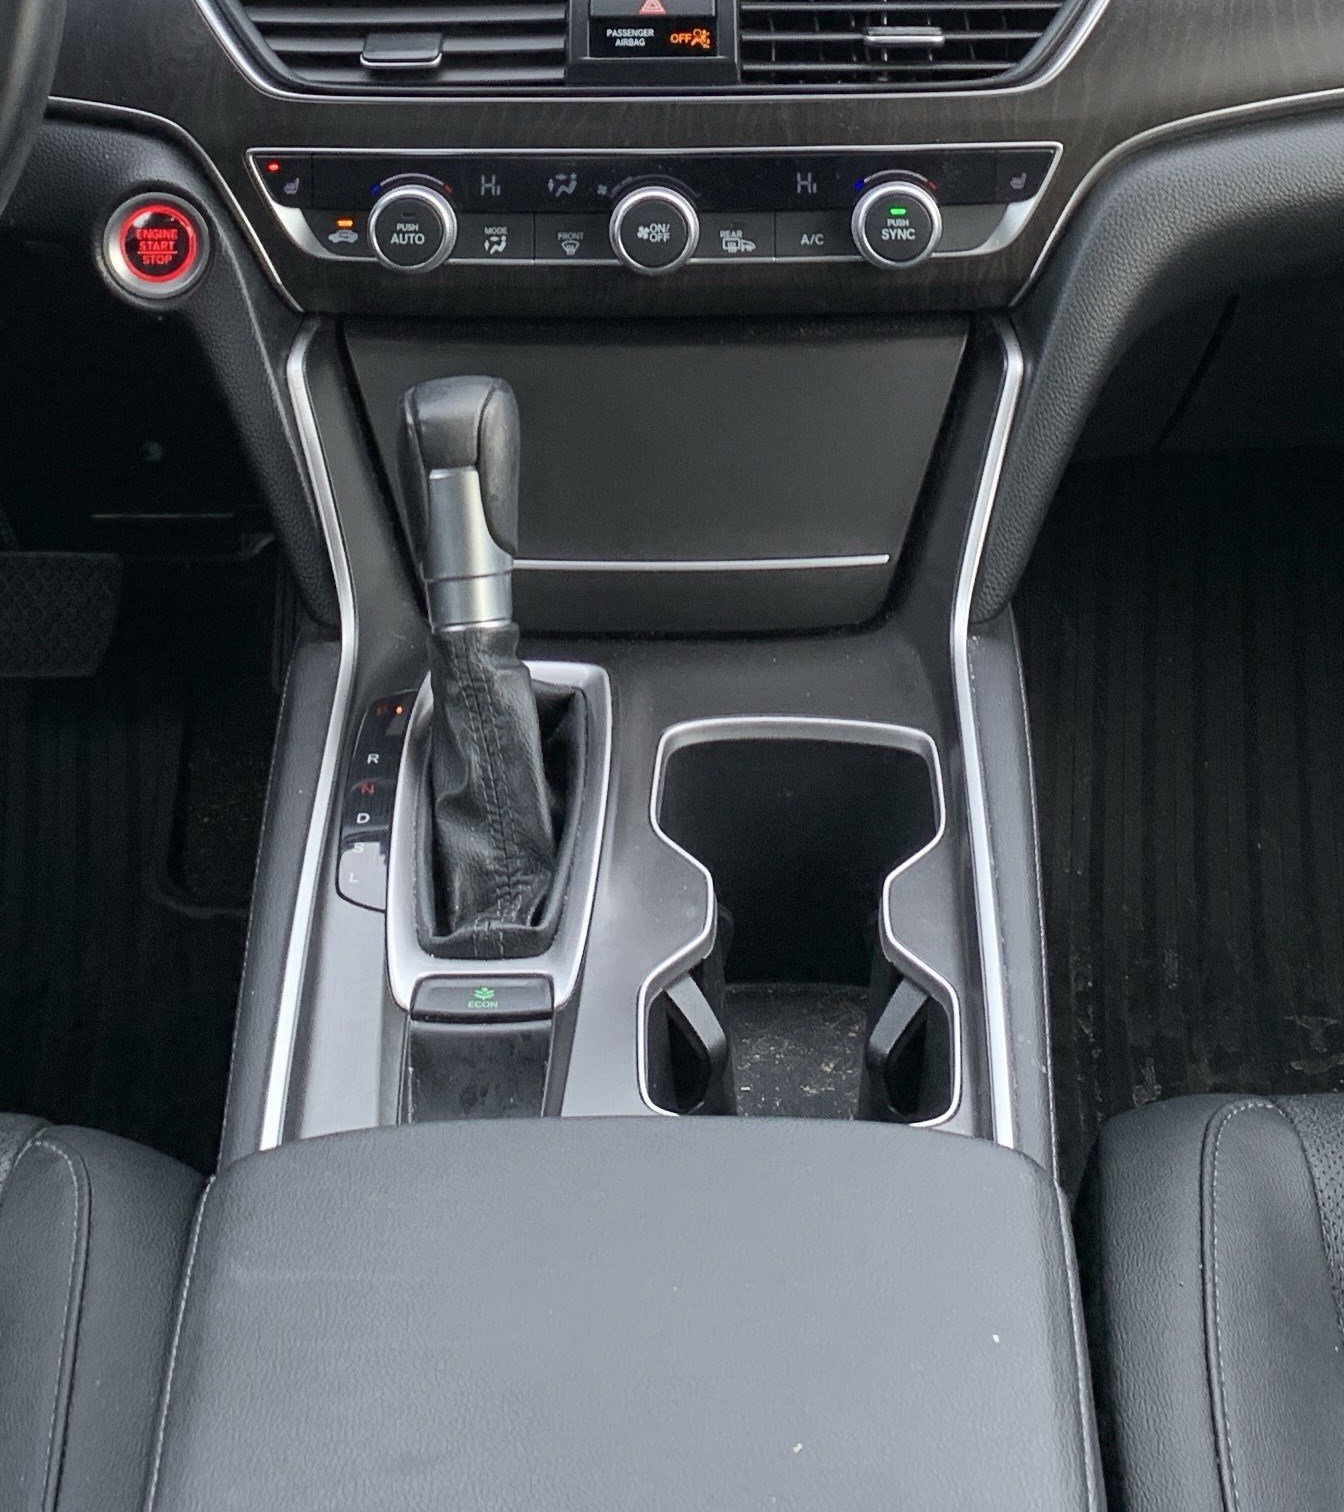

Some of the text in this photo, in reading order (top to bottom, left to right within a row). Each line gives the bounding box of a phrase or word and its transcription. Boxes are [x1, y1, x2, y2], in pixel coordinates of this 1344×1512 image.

[606, 28, 655, 38] PASSENGER
[615, 38, 646, 47] AIRBAG
[670, 33, 692, 44] OFF
[396, 223, 419, 232] PUSH
[649, 223, 670, 233] ON/
[887, 219, 909, 227] PUSH
[135, 228, 178, 240] ENGINE
[484, 226, 508, 236] MODE
[558, 231, 584, 240] FRONT
[720, 230, 743, 239] REAR
[881, 228, 916, 240] SYNC
[391, 233, 425, 245] AUTO
[649, 233, 670, 243] OFF
[800, 234, 824, 245] A/C
[139, 241, 175, 251] START
[142, 255, 173, 265] STOP
[367, 753, 380, 765] R
[360, 782, 375, 796] N
[356, 812, 370, 824] D
[349, 872, 360, 883] L
[468, 999, 499, 1009] ECON
